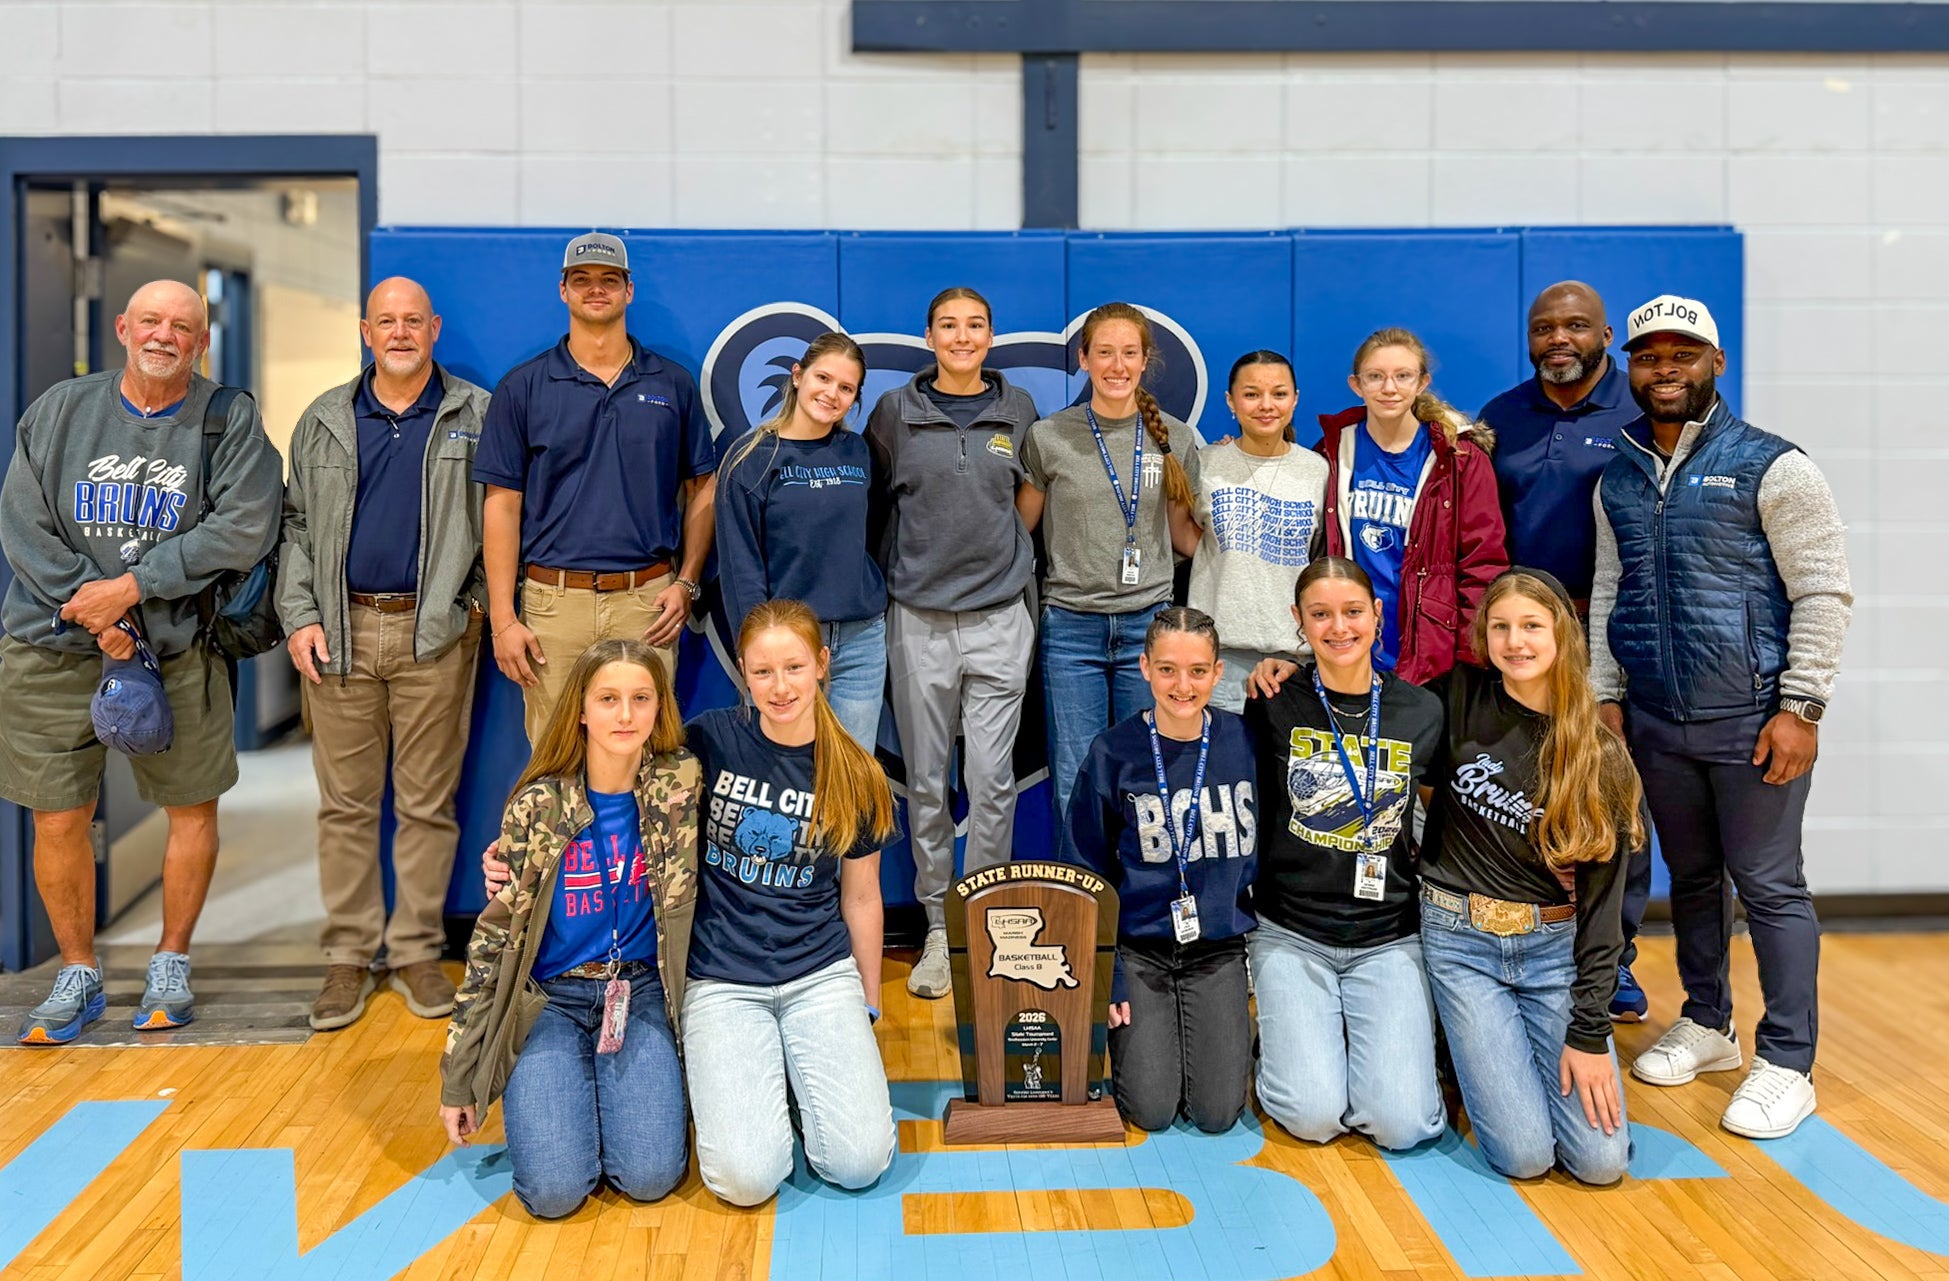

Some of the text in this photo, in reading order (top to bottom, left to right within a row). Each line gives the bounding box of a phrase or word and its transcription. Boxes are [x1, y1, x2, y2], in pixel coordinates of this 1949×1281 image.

[88, 454, 187, 492] Bell City
[795, 465, 812, 479] CITY
[814, 466, 836, 479] HIGH
[837, 465, 867, 479] SCHOOL
[1703, 475, 1736, 485] BOLTON
[75, 481, 187, 531] BRUNS
[1211, 487, 1315, 509] BELL CITY HIGH SCHOOL
[1211, 496, 1233, 508] BELL
[1235, 496, 1259, 507] CITY
[1260, 504, 1282, 517] GH
[1348, 488, 1413, 529] RUIN
[1211, 504, 1231, 517] BELL
[1212, 513, 1230, 526] BEL
[1259, 533, 1282, 546] HIGH
[1259, 541, 1281, 555] HIGH
[1283, 548, 1308, 557] SCHO
[1235, 542, 1258, 554] CITY
[1259, 551, 1281, 565] HIGH
[1282, 557, 1309, 567] SCHO
[1196, 761, 1204, 775] CITY
[1476, 753, 1504, 775] Lady
[713, 769, 773, 808] BELL
[779, 788, 815, 818] CIT
[710, 796, 745, 828] BE
[1135, 780, 1257, 863] BCHS
[1166, 816, 1174, 830] CITY
[1461, 795, 1526, 835] BASKETBALL
[706, 819, 824, 865] BE TY
[1290, 821, 1393, 852] CHAMPIONHIP
[564, 833, 626, 872] BEL
[705, 839, 815, 889] BRUINS
[956, 864, 1105, 897] STATE RUNNER-UP
[1014, 963, 1035, 971] Class
[1019, 1012, 1046, 1023] 2026
